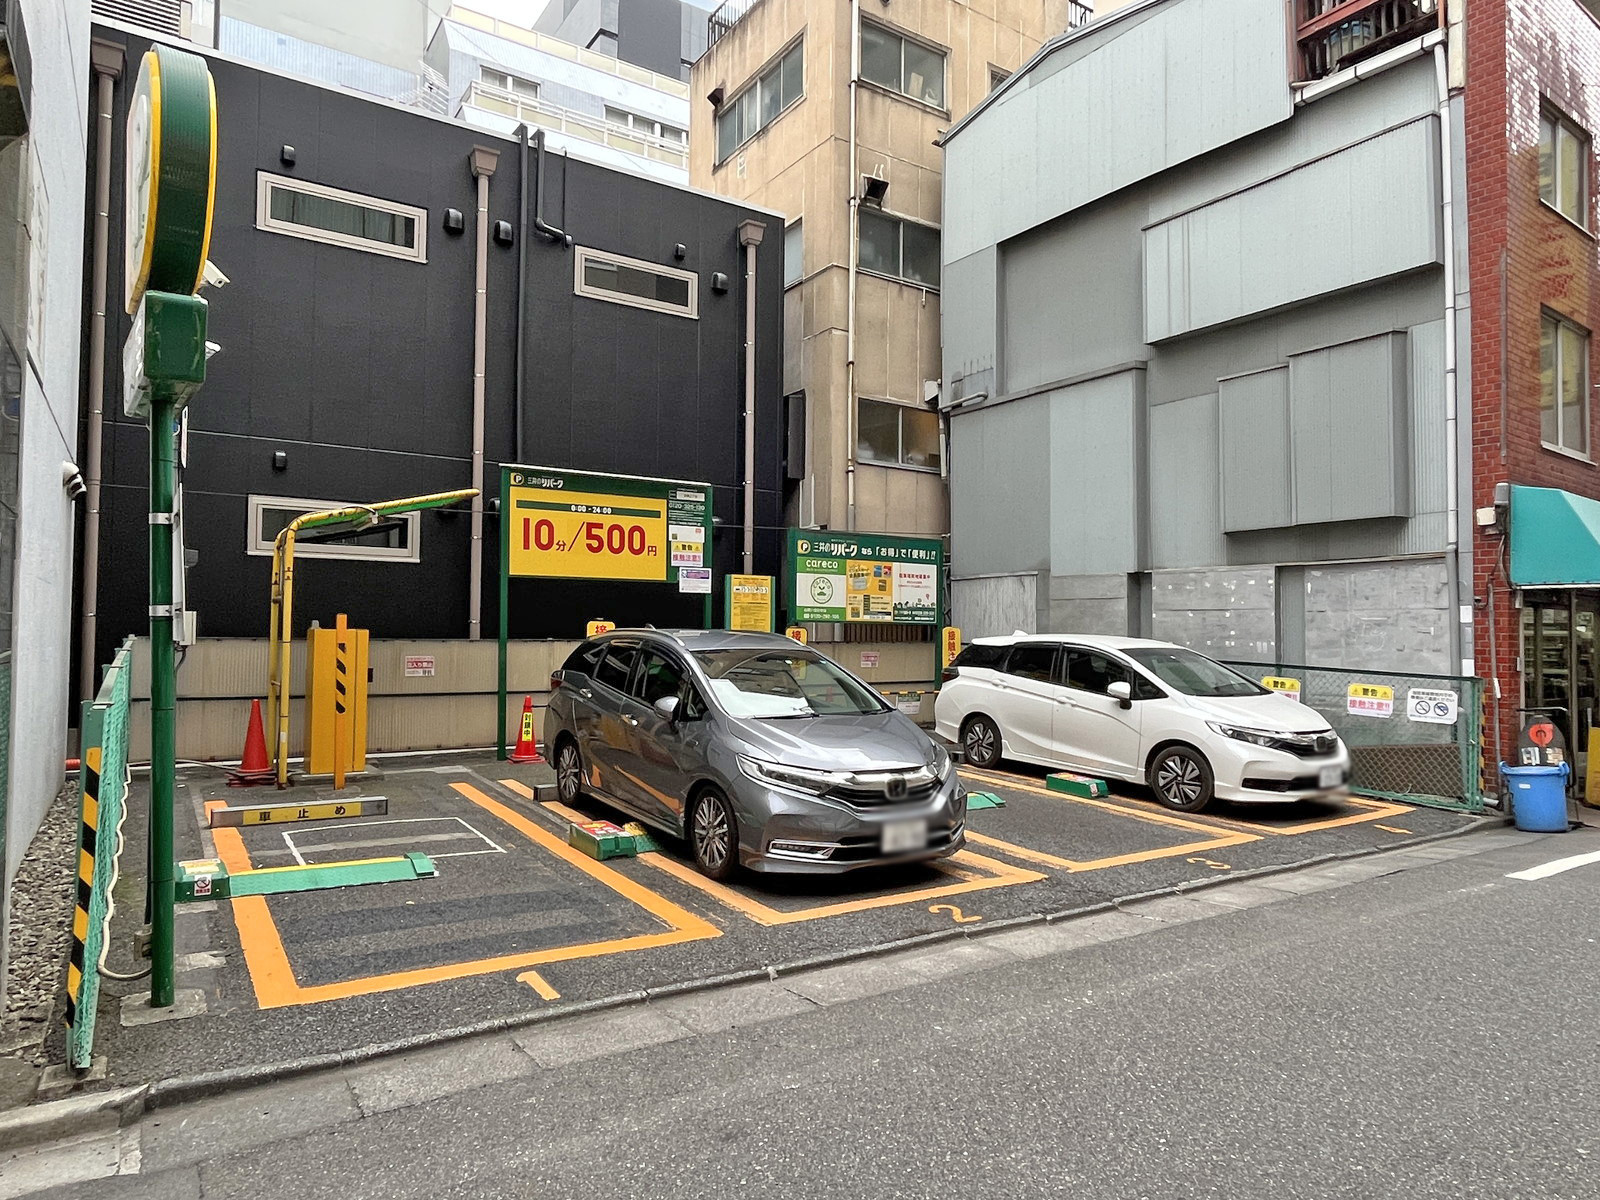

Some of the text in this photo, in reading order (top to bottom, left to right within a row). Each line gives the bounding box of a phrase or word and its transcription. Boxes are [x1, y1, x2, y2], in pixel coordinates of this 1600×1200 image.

[592, 506, 612, 514] 24:00
[813, 541, 858, 557] 三井のリパーク
[805, 559, 839, 569] careco
[1273, 680, 1287, 689] 警告
[1362, 687, 1378, 697] 警告
[259, 805, 346, 822] 車止め
[1186, 857, 1232, 871] 3
[928, 903, 982, 924] 2
[516, 969, 561, 1001] 1
